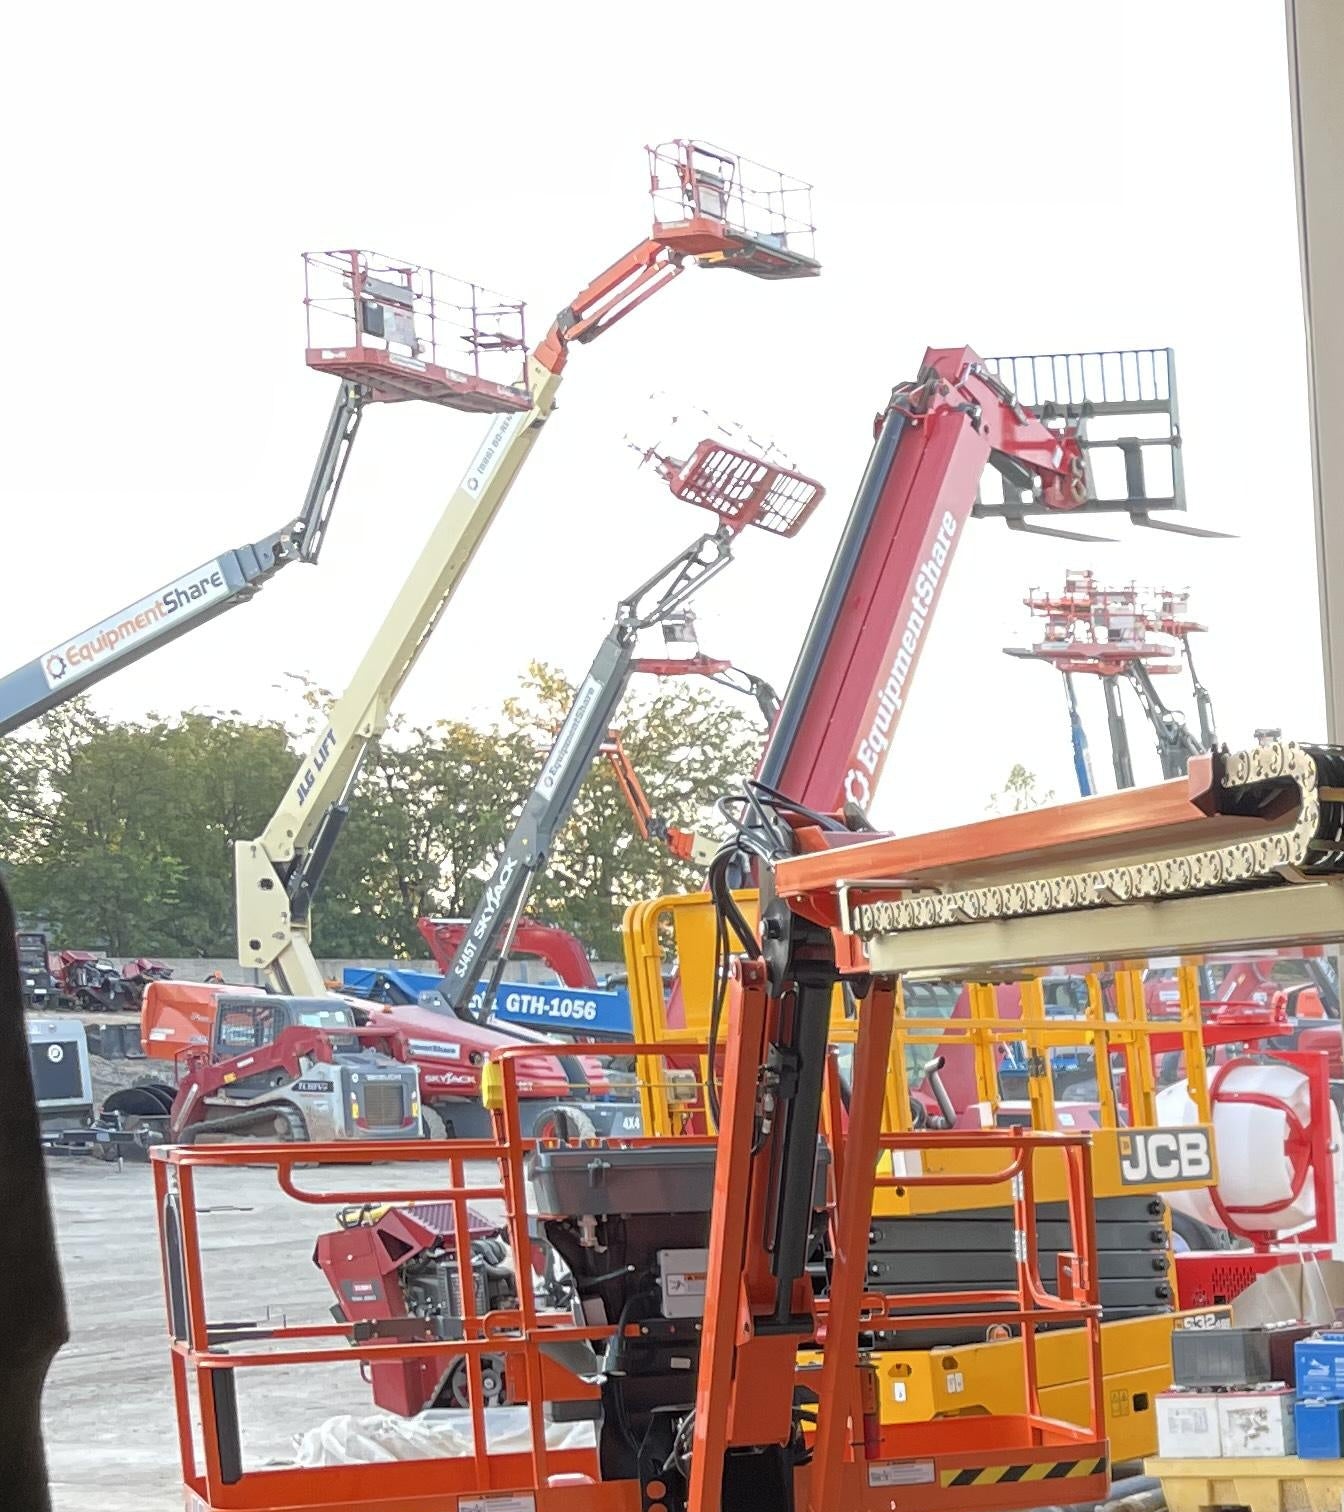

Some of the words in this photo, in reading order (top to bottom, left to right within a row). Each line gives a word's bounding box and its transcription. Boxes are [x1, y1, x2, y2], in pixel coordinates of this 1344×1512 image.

[65, 571, 223, 667] EquipmentShare
[857, 510, 956, 776] EquipmentShare
[297, 768, 315, 806] JLG
[313, 728, 336, 771] LIFT
[549, 686, 596, 779] EquipmentShare
[473, 856, 518, 940] SKYJACK
[506, 993, 597, 1020] GTH-1056
[1122, 1133, 1210, 1181] JCB
